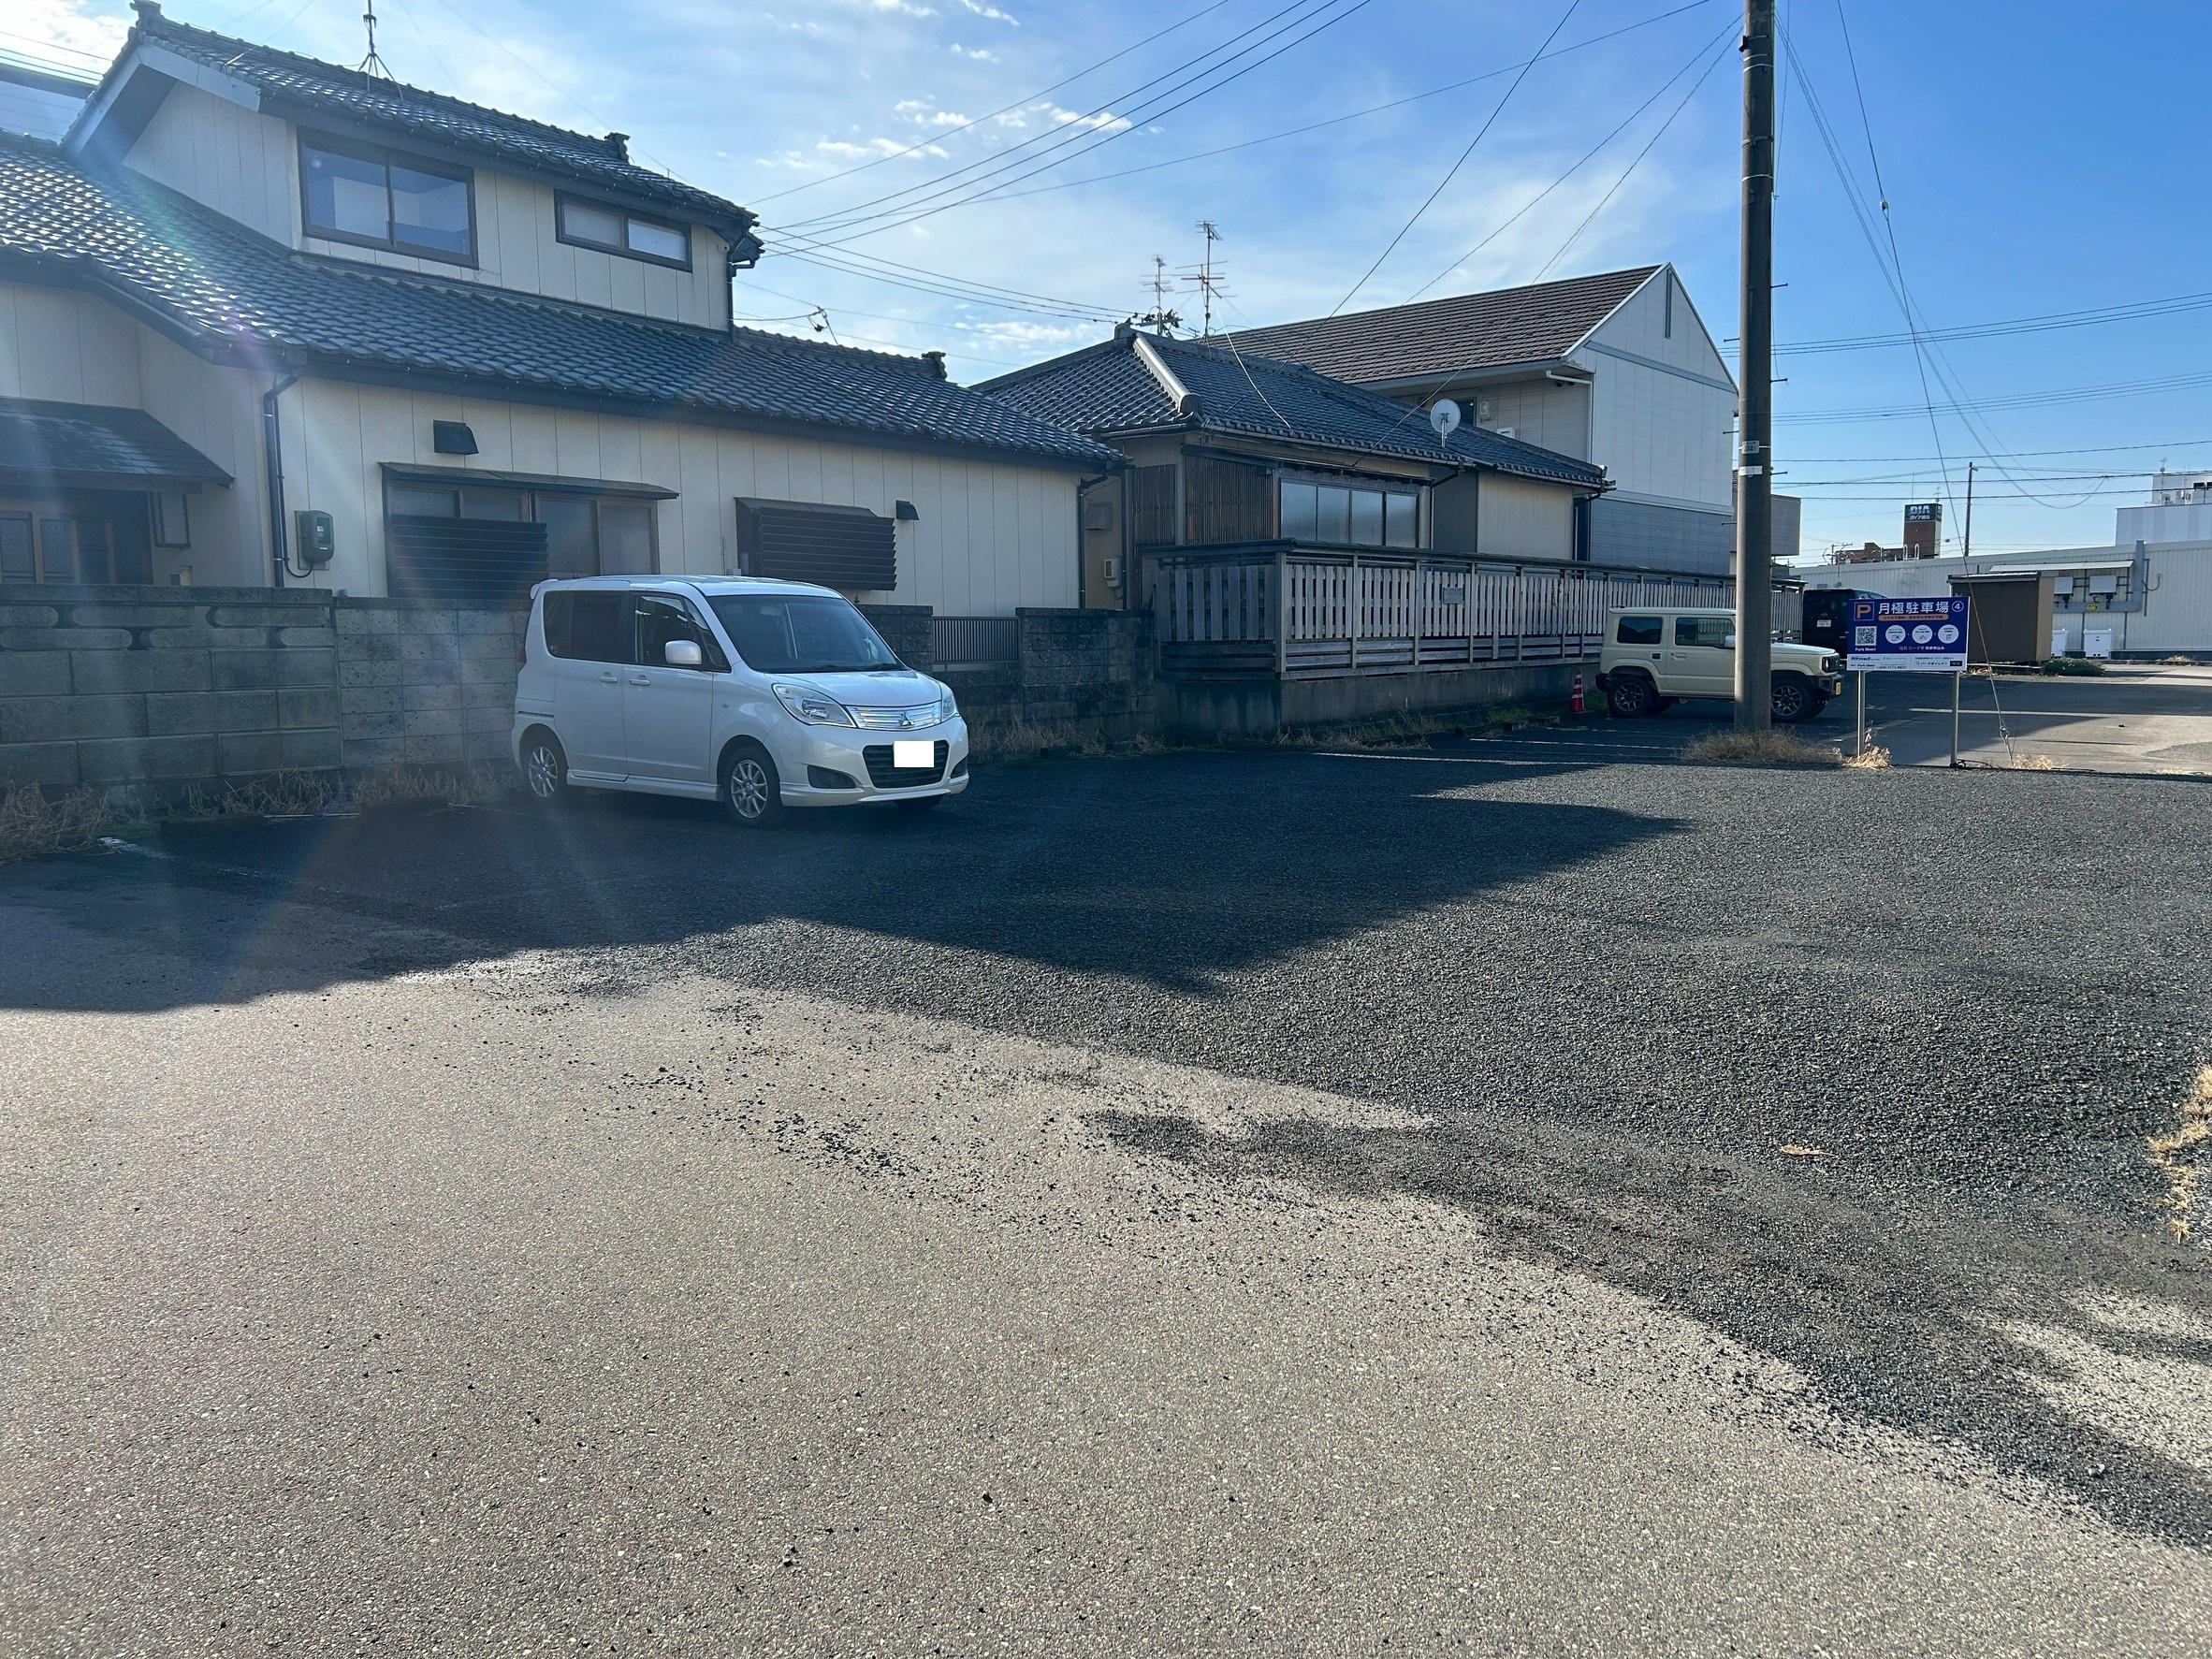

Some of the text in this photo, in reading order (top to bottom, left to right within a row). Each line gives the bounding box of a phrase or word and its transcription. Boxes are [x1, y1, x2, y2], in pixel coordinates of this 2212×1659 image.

[1856, 604, 1871, 618] P
[1878, 601, 1949, 614] 月極駐車場
